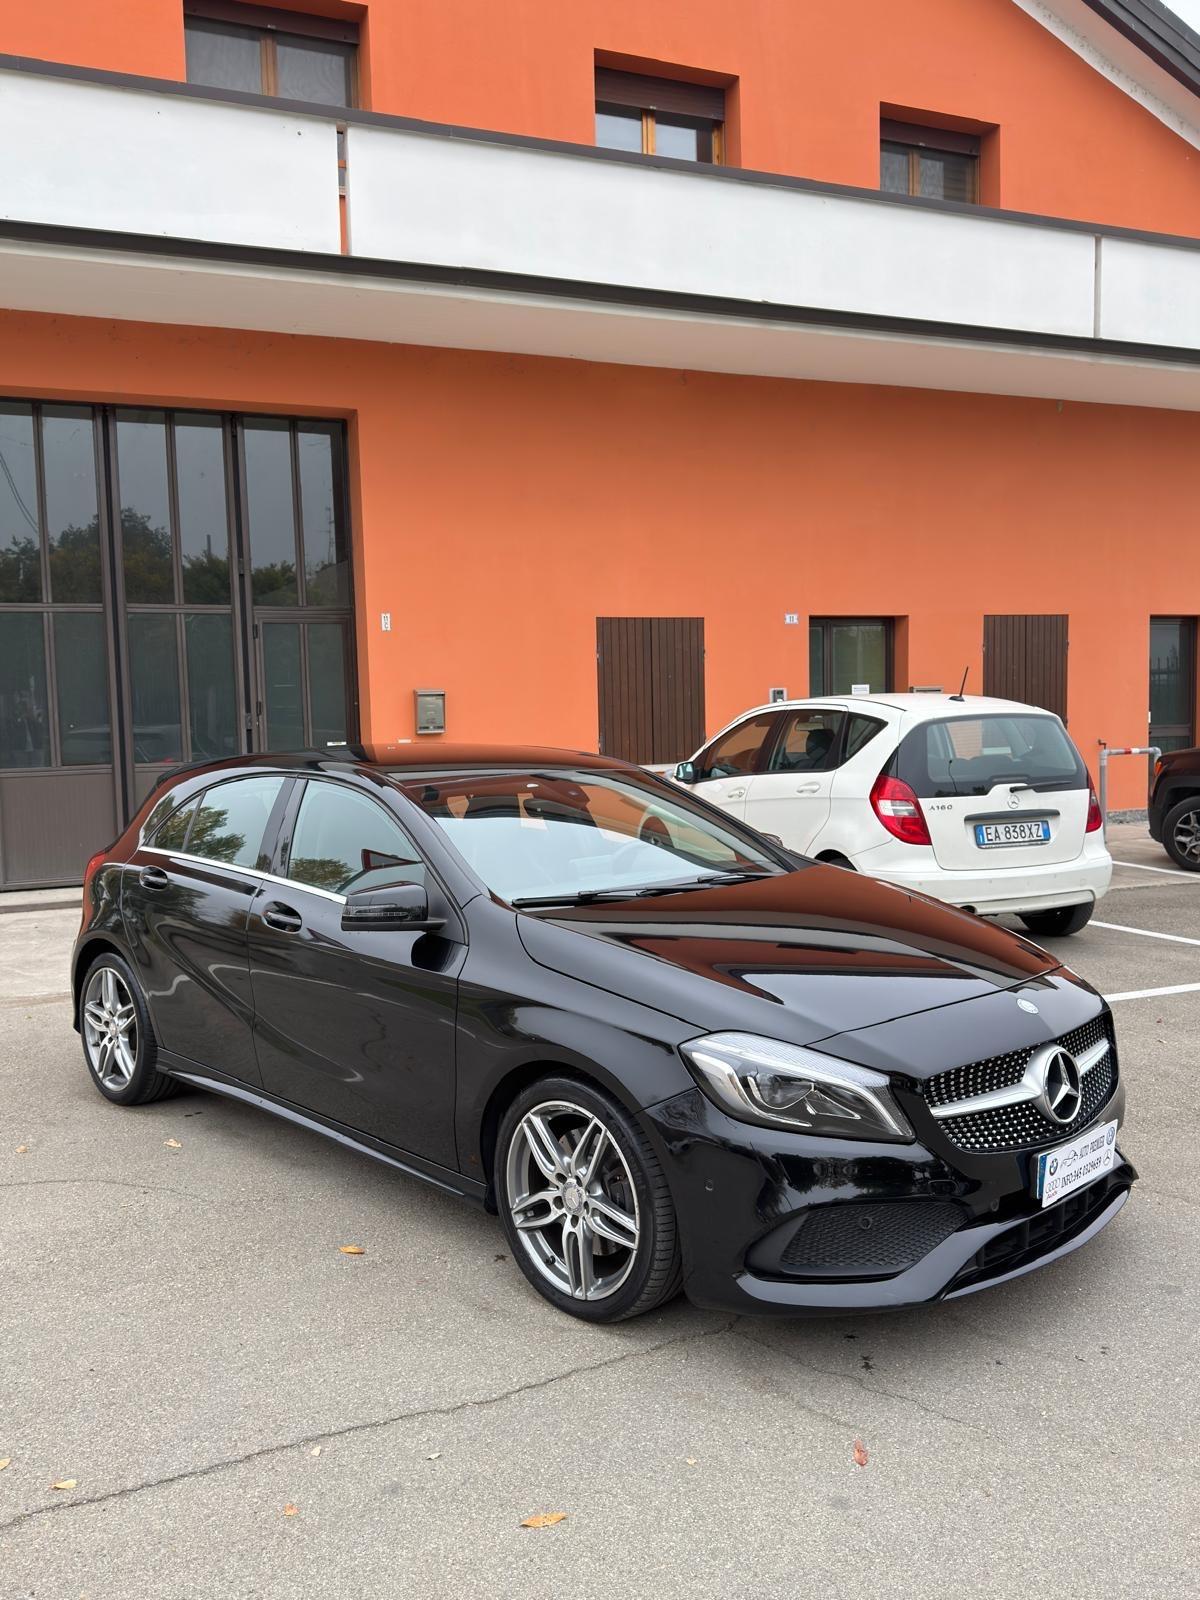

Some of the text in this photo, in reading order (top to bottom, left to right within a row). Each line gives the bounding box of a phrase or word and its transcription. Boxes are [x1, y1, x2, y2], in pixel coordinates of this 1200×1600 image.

[985, 823, 1042, 842] EA 838XZ
[1079, 1144, 1089, 1159] AUTO
